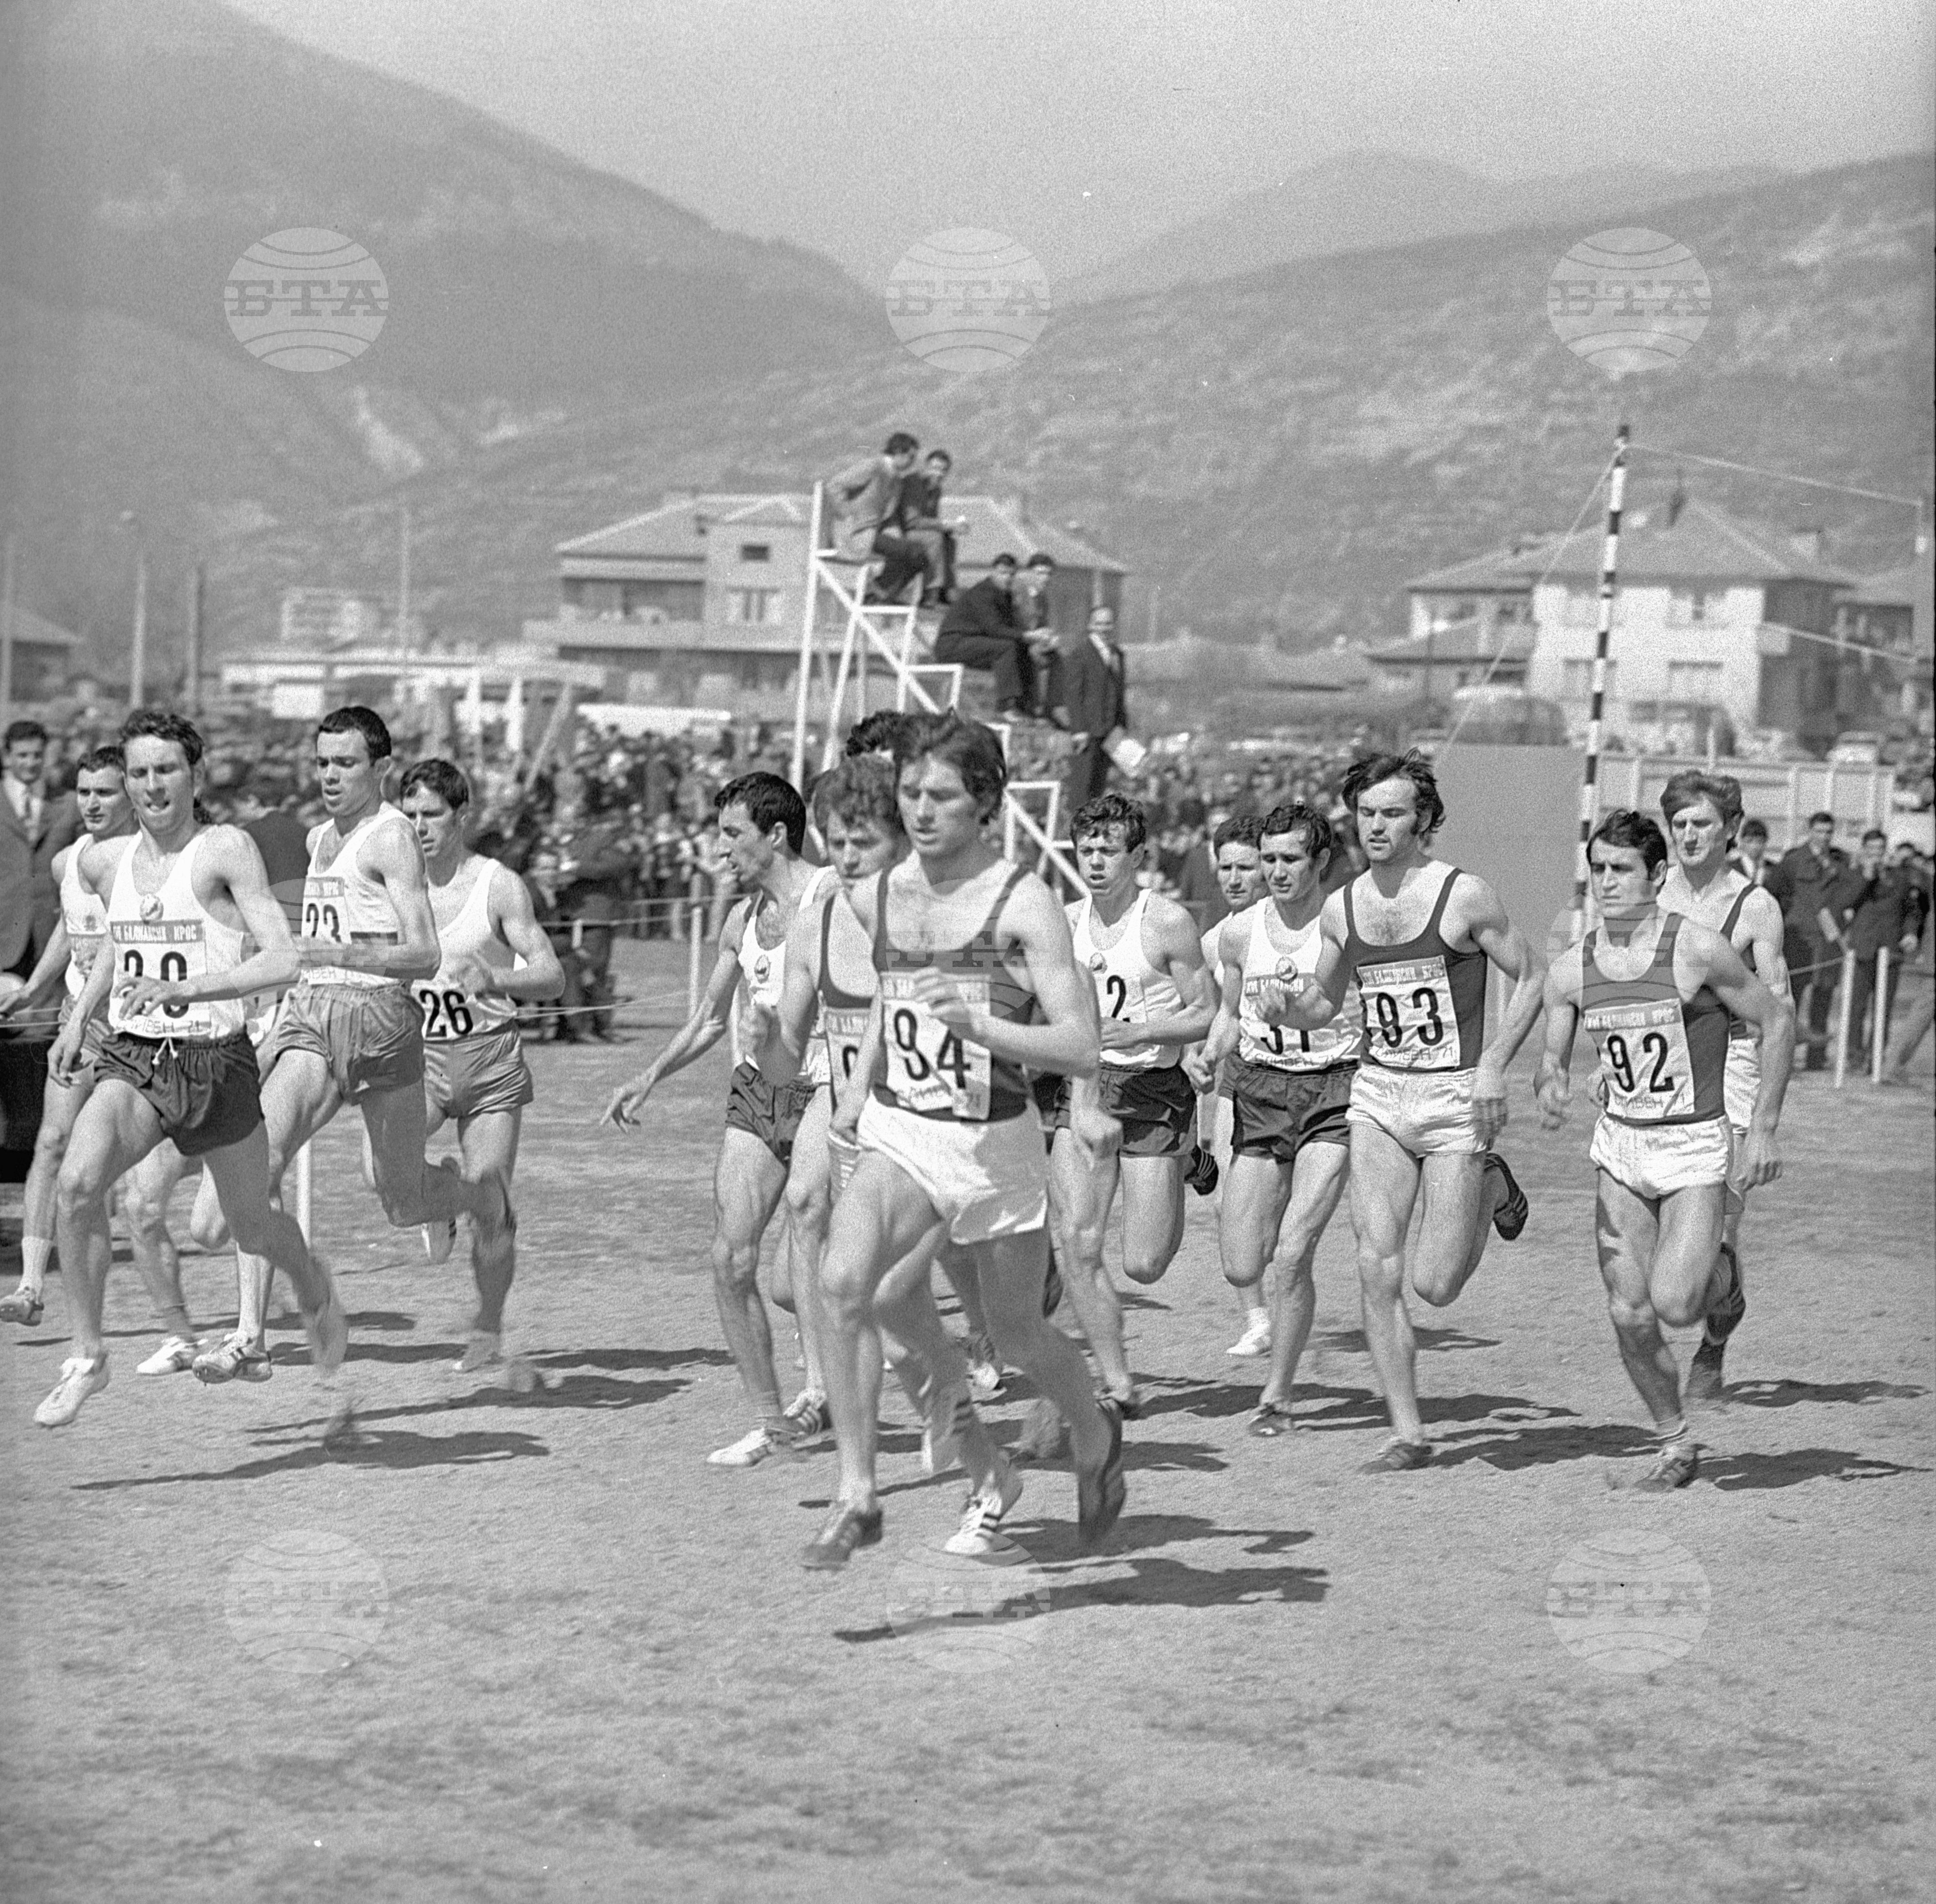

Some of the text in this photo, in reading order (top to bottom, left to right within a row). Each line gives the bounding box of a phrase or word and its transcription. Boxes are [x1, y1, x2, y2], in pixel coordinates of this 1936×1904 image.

[174, 924, 197, 941] КРОС
[420, 990, 473, 1035] 26
[1376, 987, 1444, 1048] 93
[895, 1008, 970, 1089] 94
[1607, 1032, 1675, 1093] 92
